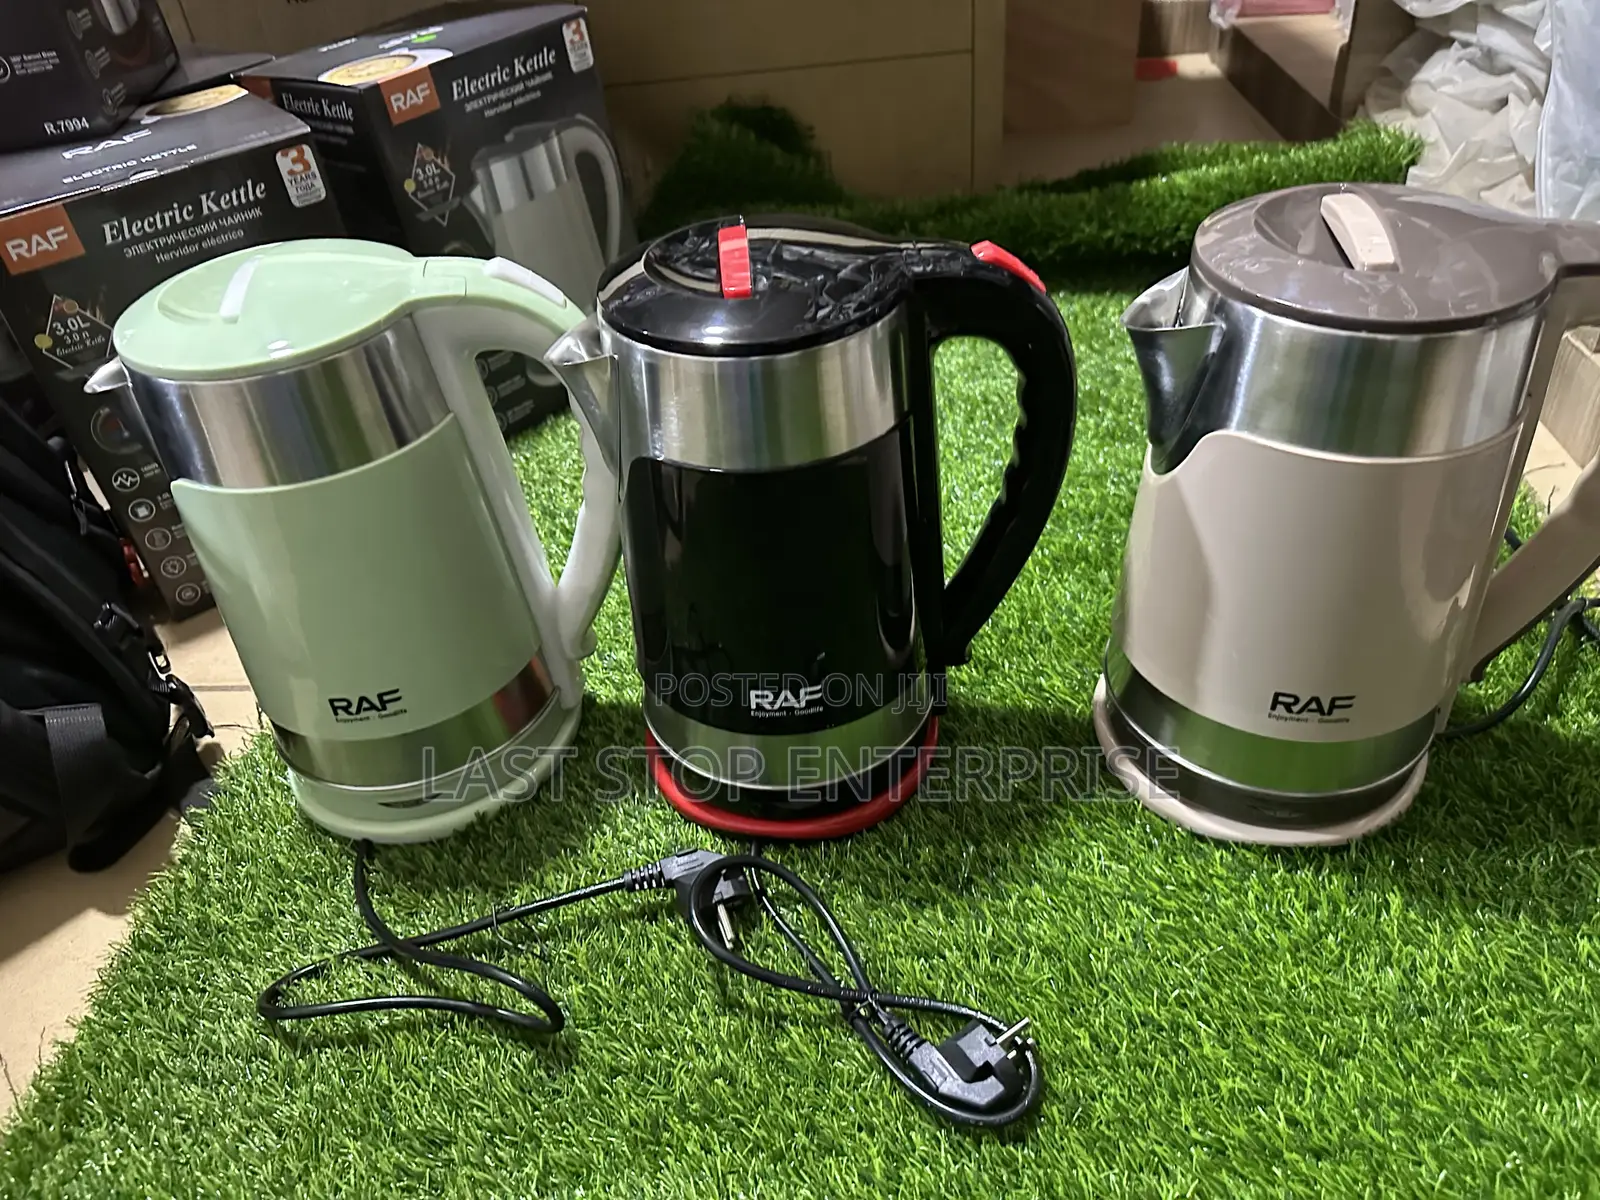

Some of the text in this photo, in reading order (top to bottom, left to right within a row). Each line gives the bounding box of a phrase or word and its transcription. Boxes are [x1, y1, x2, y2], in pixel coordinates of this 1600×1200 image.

[452, 64, 510, 101] Electric
[514, 46, 556, 78] Kettle
[282, 92, 354, 122] Electric Kettle
[391, 82, 430, 113] RAF
[62, 128, 152, 160] RAF
[62, 143, 198, 184] ELECTRIC KETTLE
[280, 145, 311, 176] 3
[287, 171, 317, 187] YEARS
[295, 182, 316, 193] ГОДА
[102, 178, 267, 245] Electric Kettle
[219, 206, 263, 228] ЧАЙНИК
[5, 226, 69, 262] RAF
[155, 228, 244, 264] Hervidor eléctrico
[53, 315, 91, 336] 3.0L
[327, 688, 402, 716] RAF
[749, 685, 823, 711] RAF
[1269, 691, 1356, 716] RAF
[750, 709, 787, 719] Enjoyment
